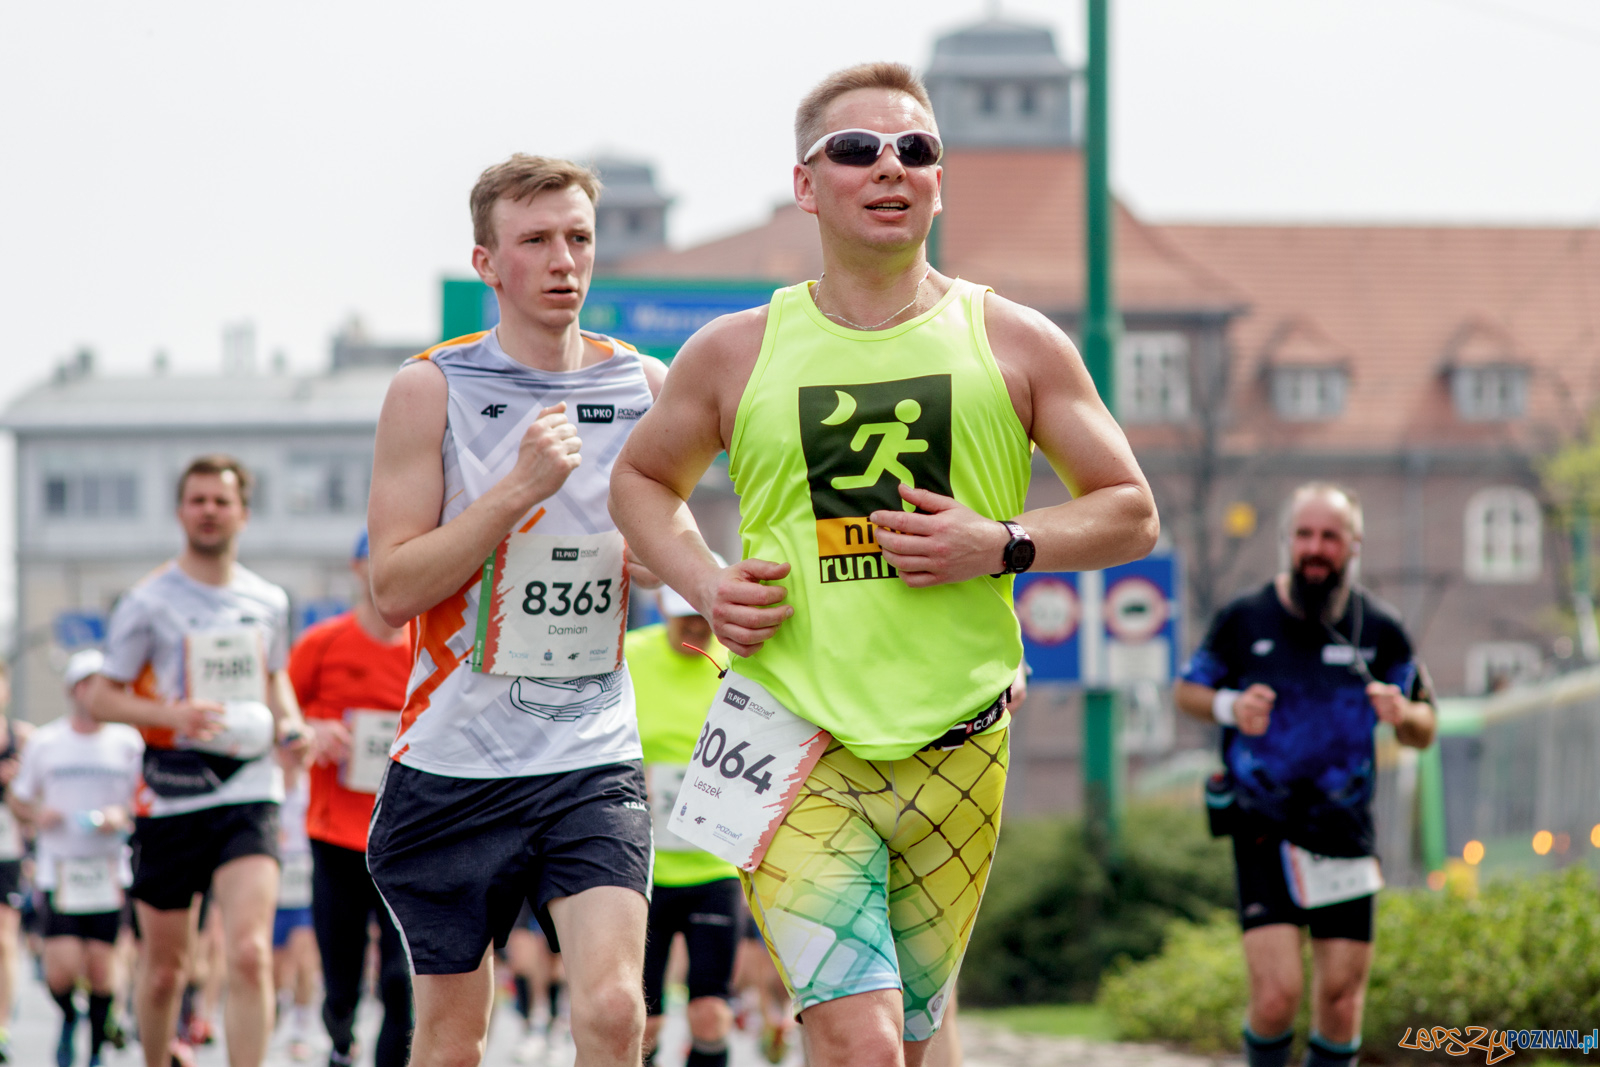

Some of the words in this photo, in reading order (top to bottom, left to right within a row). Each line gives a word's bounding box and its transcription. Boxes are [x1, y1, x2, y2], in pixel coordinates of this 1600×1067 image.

[481, 404, 507, 418] 4F
[522, 578, 612, 617] 8363
[548, 624, 588, 636] Damian
[693, 776, 723, 799] Leszek
[694, 816, 707, 824] 4F
